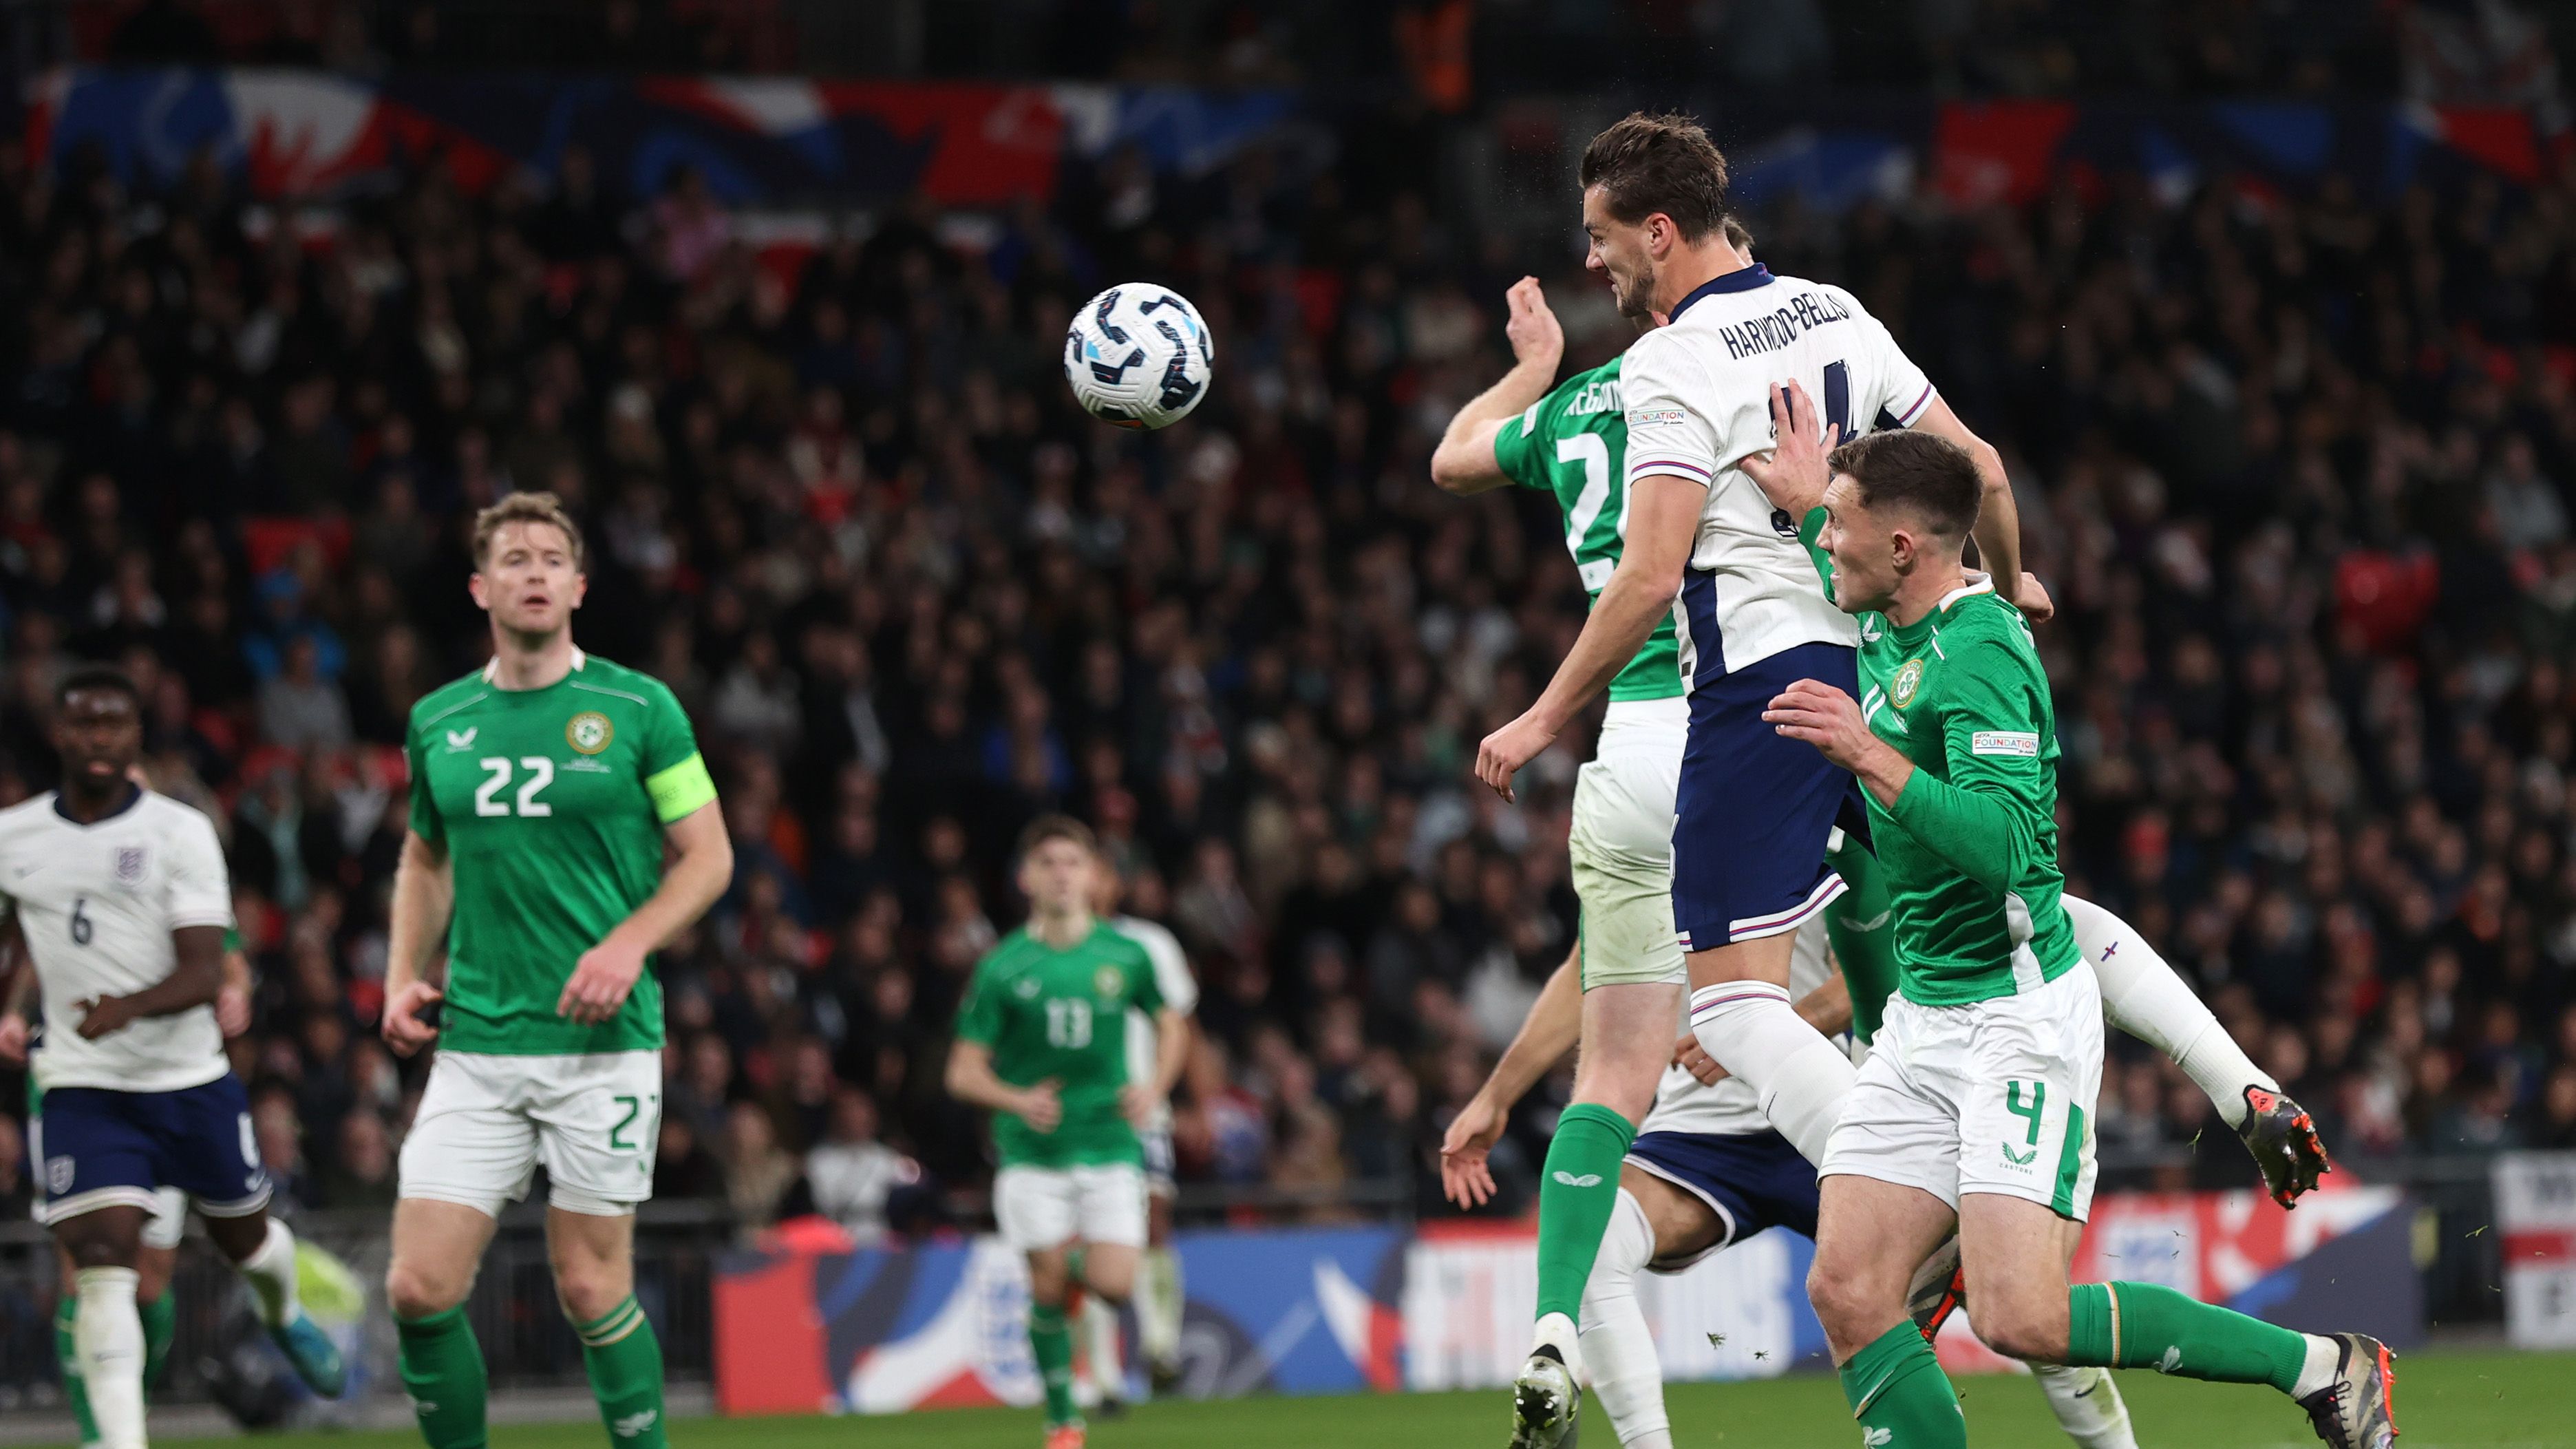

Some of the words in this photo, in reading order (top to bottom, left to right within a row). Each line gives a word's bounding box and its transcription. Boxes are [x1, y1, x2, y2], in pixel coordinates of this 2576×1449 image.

[1719, 293, 1849, 360] HARWOOD-BELLIS
[1629, 412, 1684, 423] FOUNDATION
[1974, 738, 2036, 749] FOUNDATION
[474, 756, 555, 818] 22
[70, 898, 92, 946] 6
[2006, 1080, 2045, 1147] 4
[1999, 1162, 2034, 1176] CASTORE
